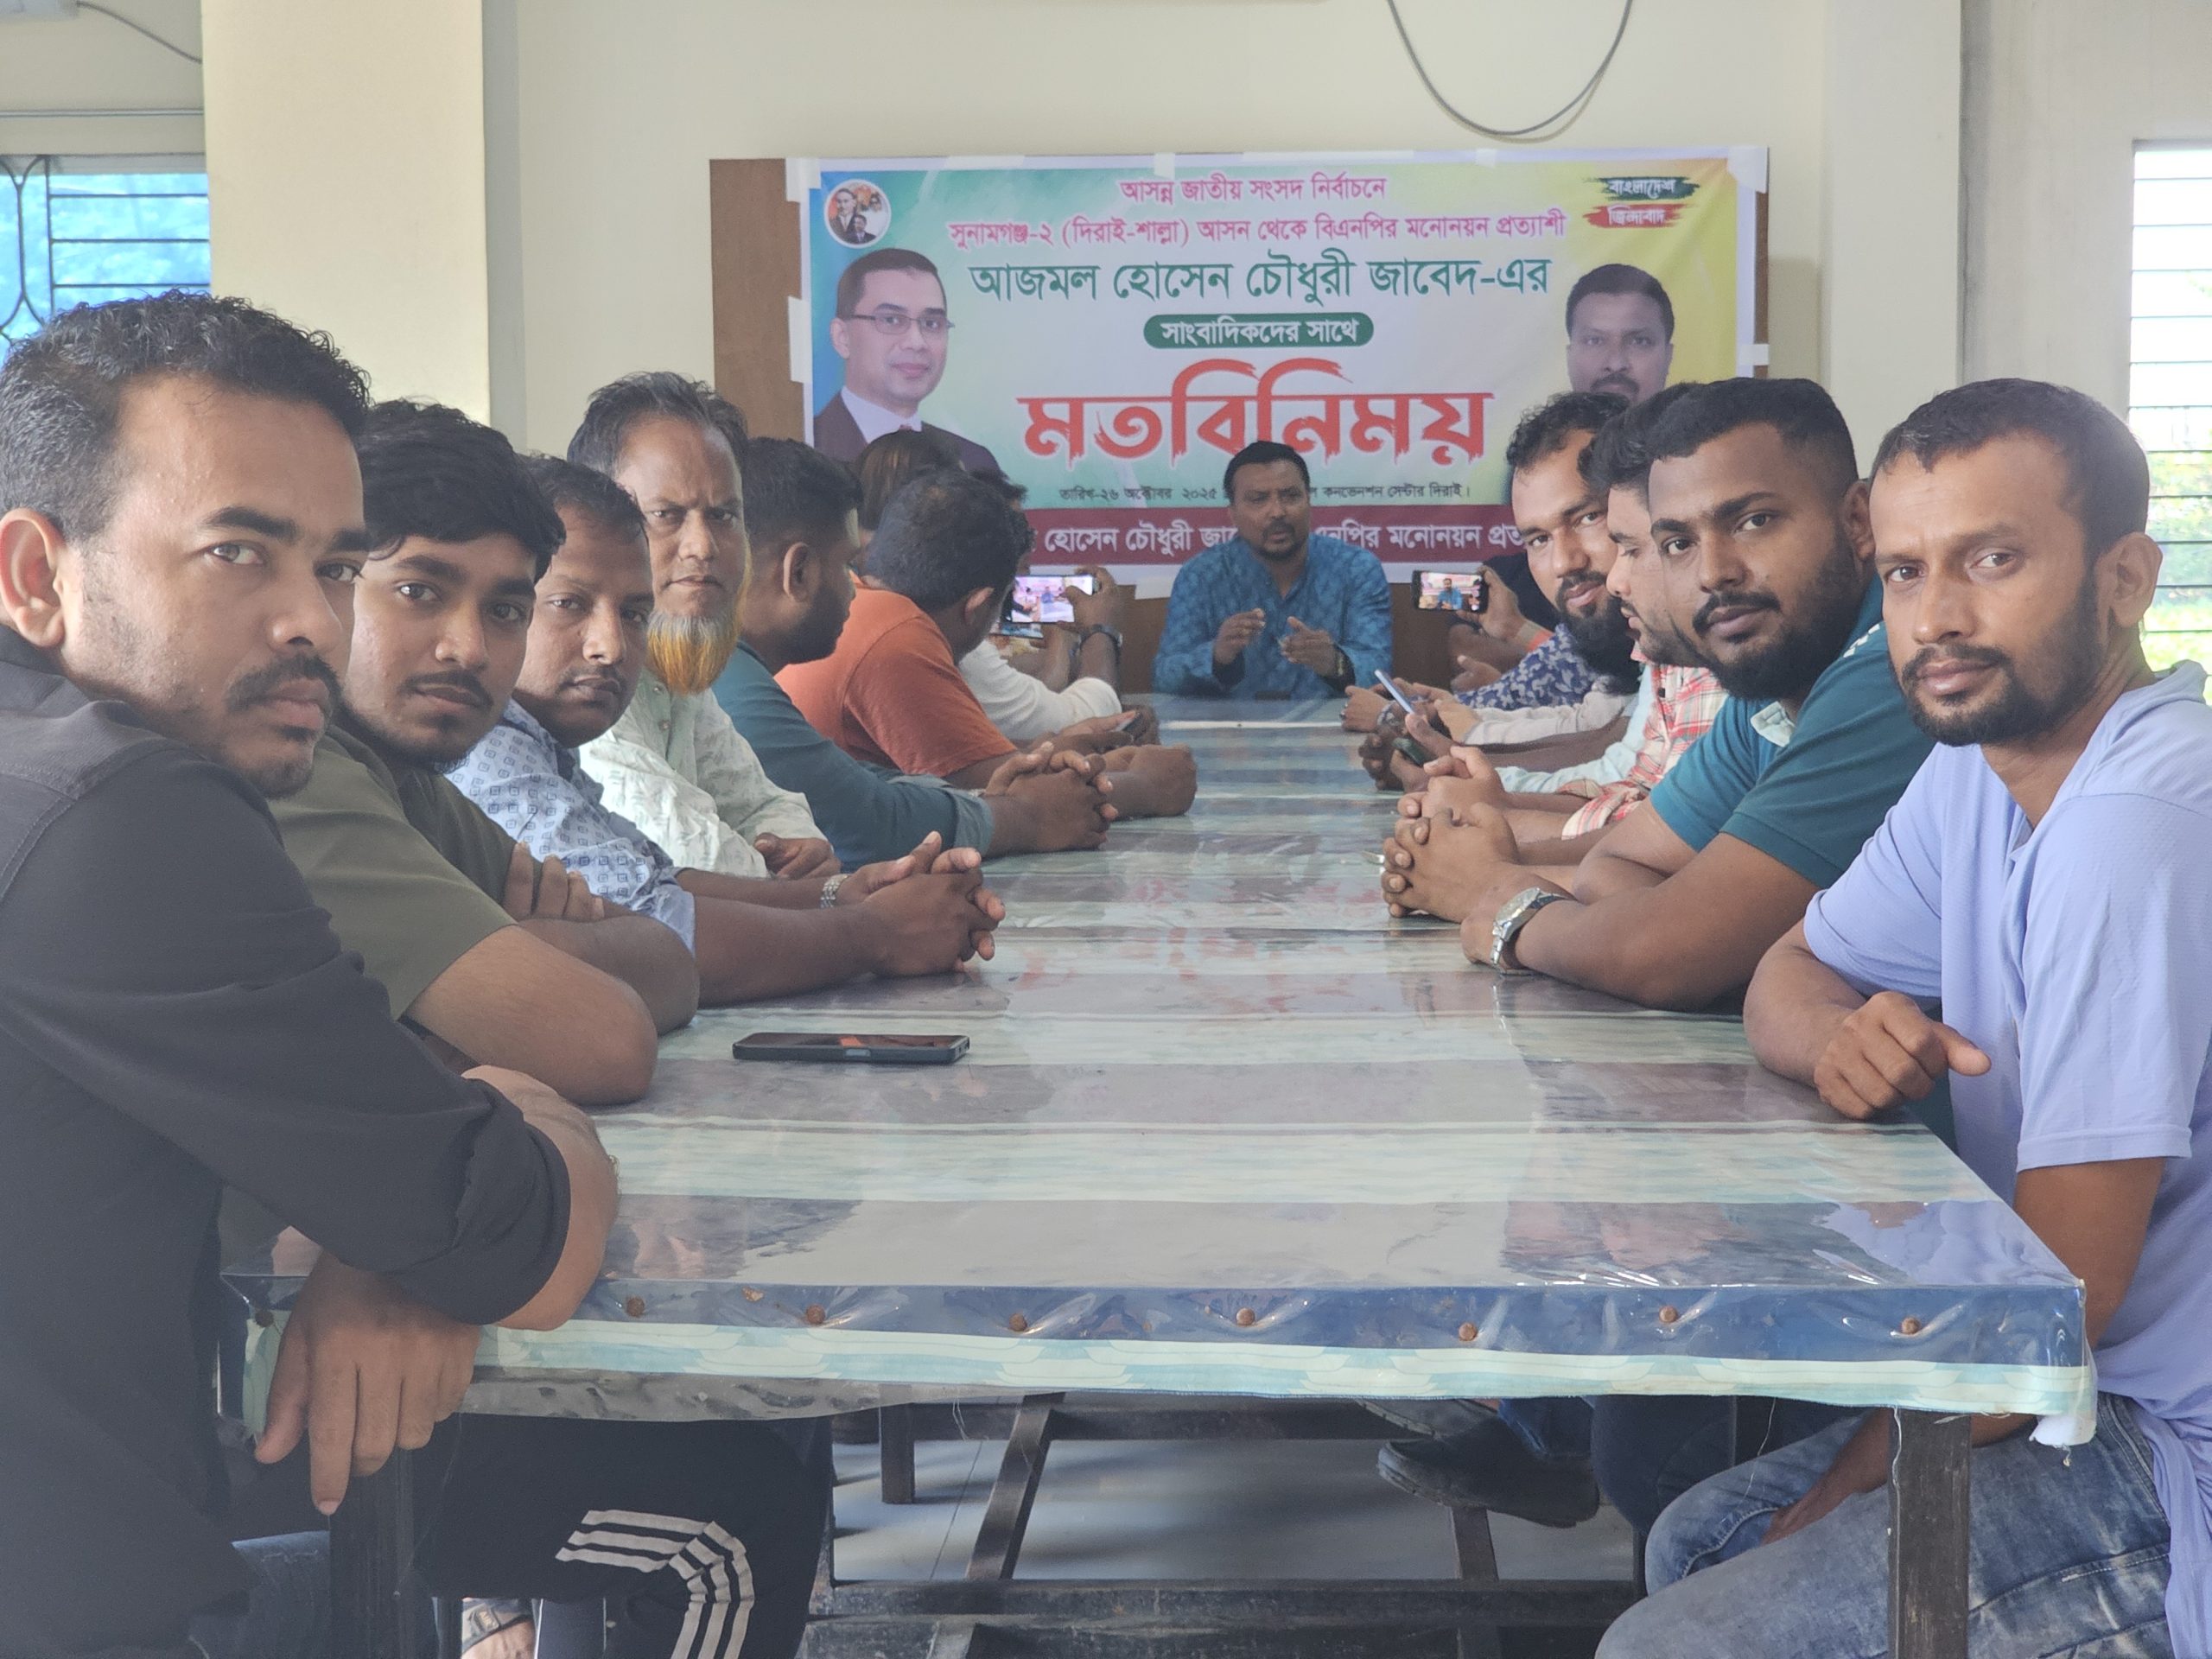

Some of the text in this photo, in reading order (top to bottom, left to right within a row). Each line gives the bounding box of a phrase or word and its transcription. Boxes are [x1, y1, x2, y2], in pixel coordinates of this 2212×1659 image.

[1120, 171, 1387, 204] আসন্ন জাতীয় সংসদ নির্বাচনে
[1608, 178, 1676, 199] বাংলাদেশ
[949, 207, 1567, 249] সুনামগঞ্জ-২ (দিরাই-শাল্লা) আসন থেকে বিএনপির মনোনয়ন প্রত্যাশী
[968, 246, 1553, 307] আজমল হোসেন চৌধুরী জাবেদ-এর
[1160, 315, 1360, 346] সাংবাদিকদের সাথে
[1016, 357, 1496, 468] মতবিনিময়
[1182, 486, 1218, 500] ২০২৫
[1044, 528, 1120, 553] হোসেন
[1125, 518, 1194, 556] চৌধুরী
[1387, 524, 1483, 550] মনোনয়ন
